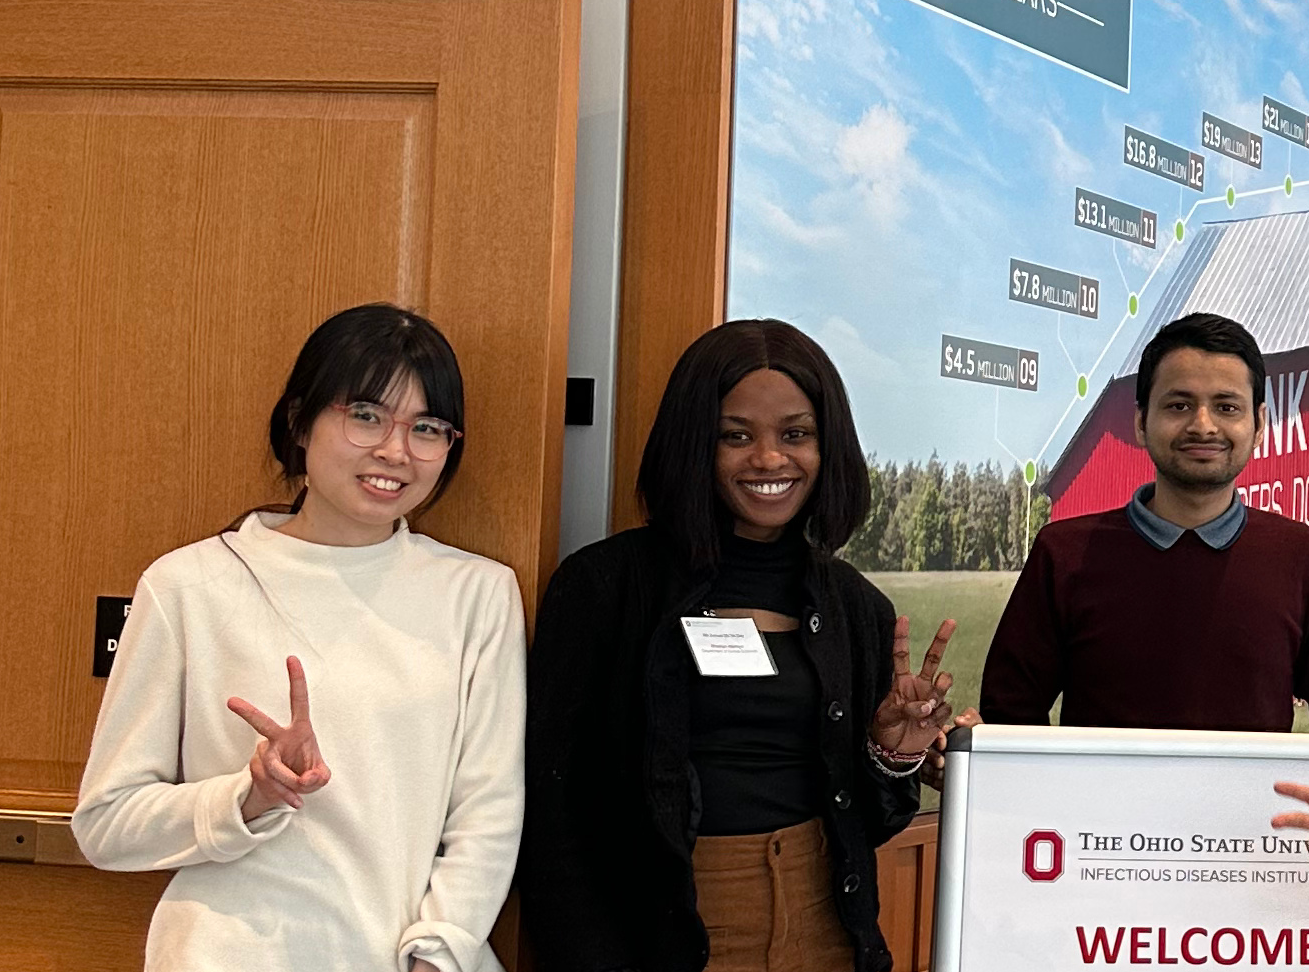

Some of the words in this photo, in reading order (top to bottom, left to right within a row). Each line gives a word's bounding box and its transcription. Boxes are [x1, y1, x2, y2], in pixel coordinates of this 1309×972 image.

[1264, 103, 1279, 132] $21
[1126, 135, 1157, 168] $16.8
[1157, 155, 1187, 180] MILLION
[1190, 159, 1203, 187] 12
[1203, 120, 1221, 149] $19
[1250, 140, 1261, 165] 13
[1077, 196, 1107, 229] $13.1
[1108, 215, 1139, 239] MILLION
[1142, 217, 1155, 243] 11
[1012, 267, 1040, 300] $7.8
[1042, 285, 1077, 309] MILLION
[1081, 285, 1097, 313] 10
[944, 344, 975, 375] $4.5
[977, 359, 1015, 382] MILLION
[1019, 358, 1037, 385] 09
[1078, 832, 1122, 851] THE
[1130, 833, 1184, 852] OHIO
[1191, 834, 1255, 853] STATE
[1080, 868, 1172, 881] INFECTIOUS
[1176, 869, 1247, 883] DISEASES
